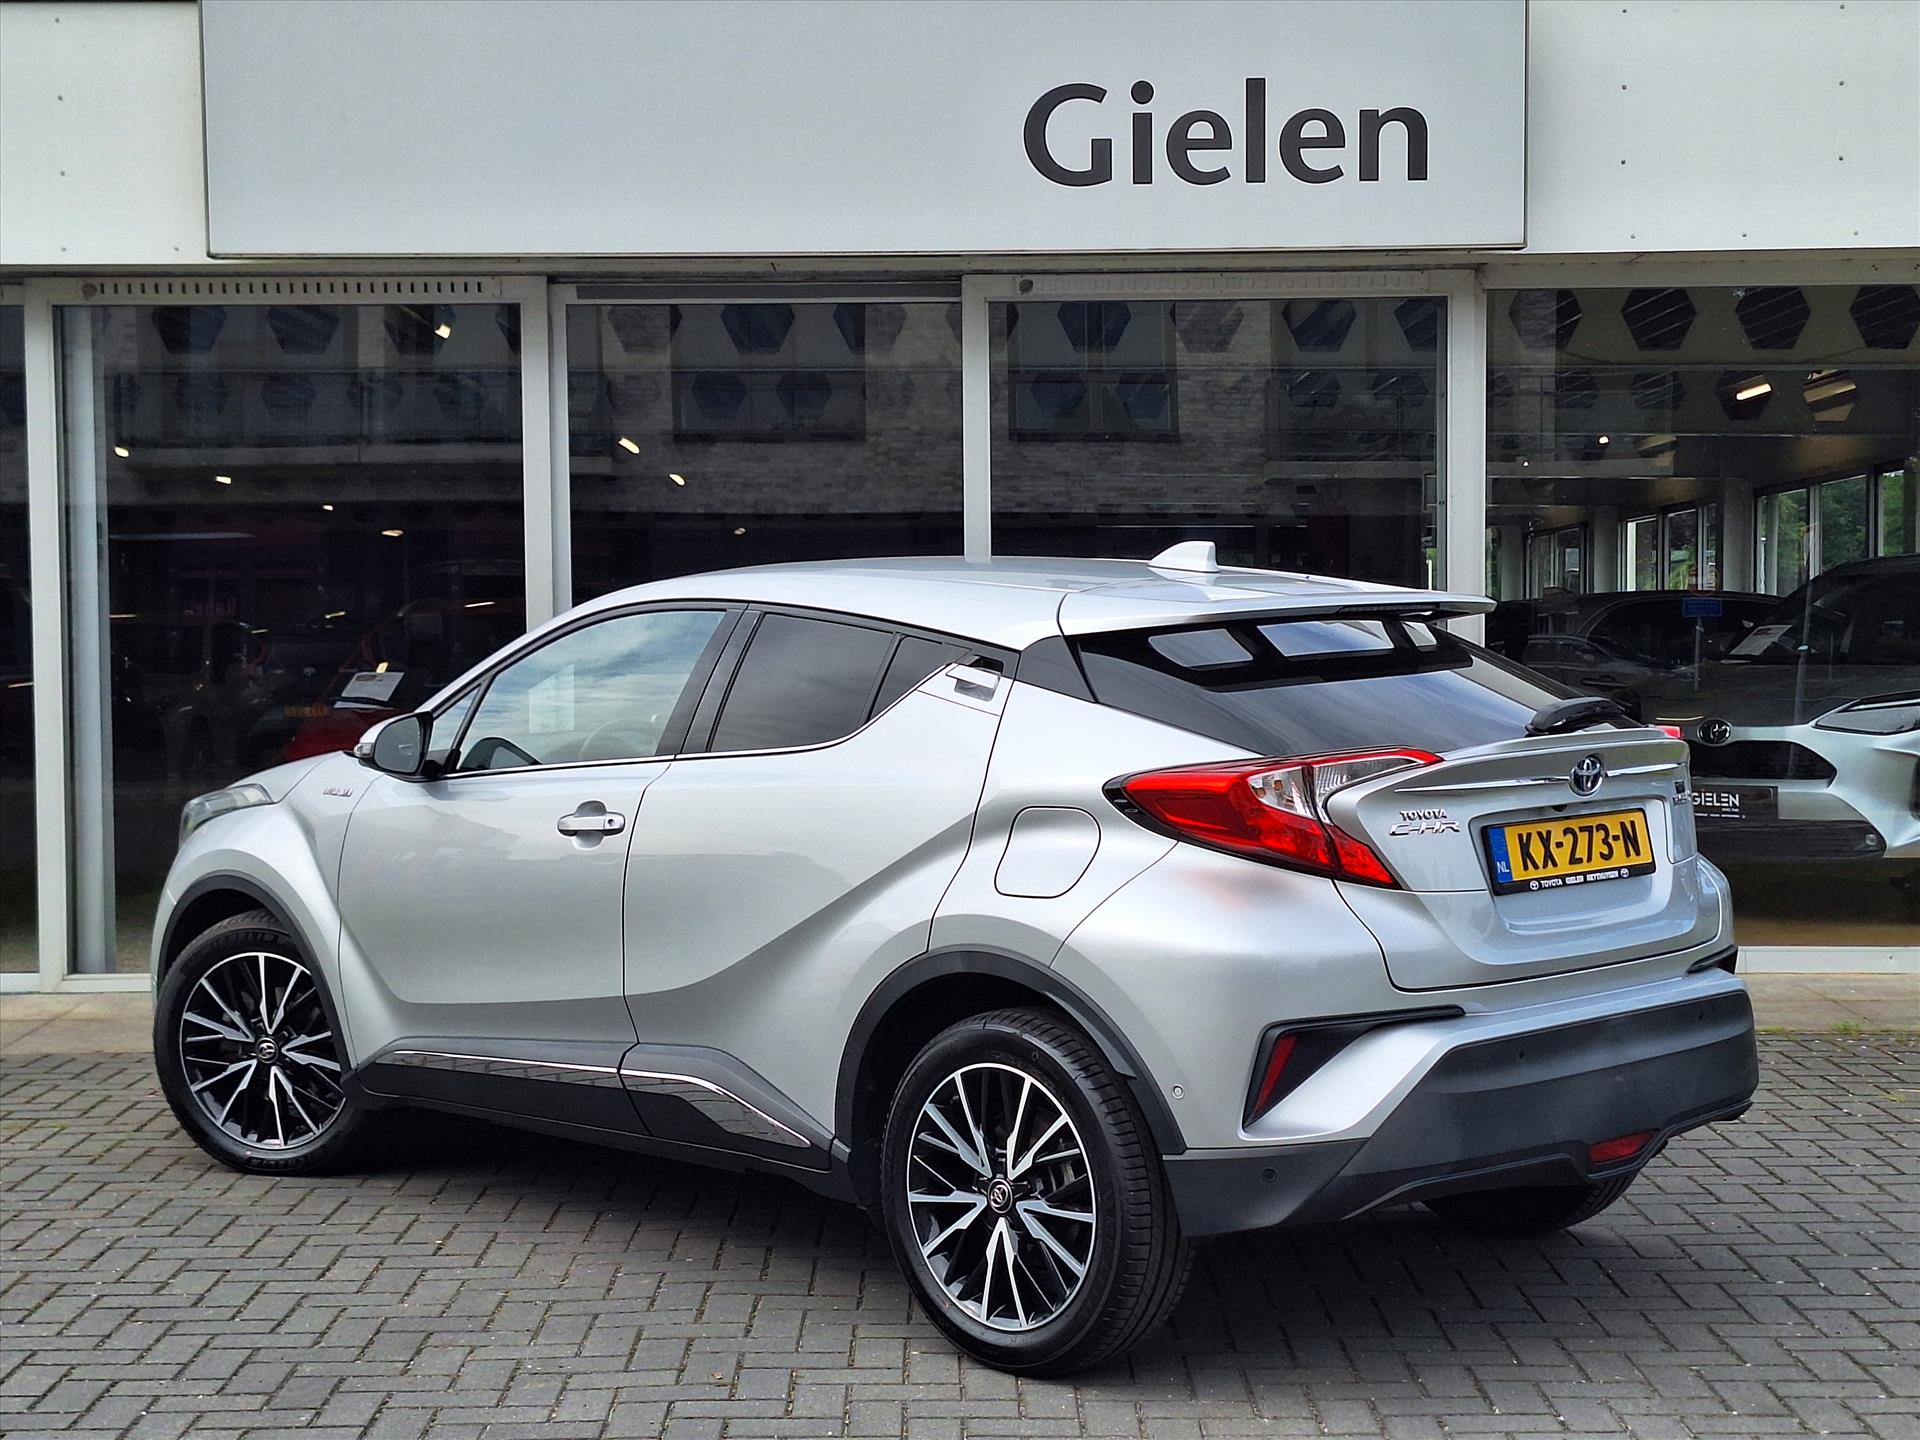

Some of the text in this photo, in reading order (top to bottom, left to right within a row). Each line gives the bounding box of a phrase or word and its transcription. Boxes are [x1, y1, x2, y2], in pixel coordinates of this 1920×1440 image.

[1023, 77, 1428, 187] Gielen
[1691, 792, 1740, 807] GIELEN
[1400, 809, 1447, 821] TOYOTA
[1389, 821, 1460, 836] C-HR
[1517, 820, 1642, 872] KX-273-N
[1497, 861, 1510, 873] NL
[1540, 878, 1563, 889] TOYOTA
